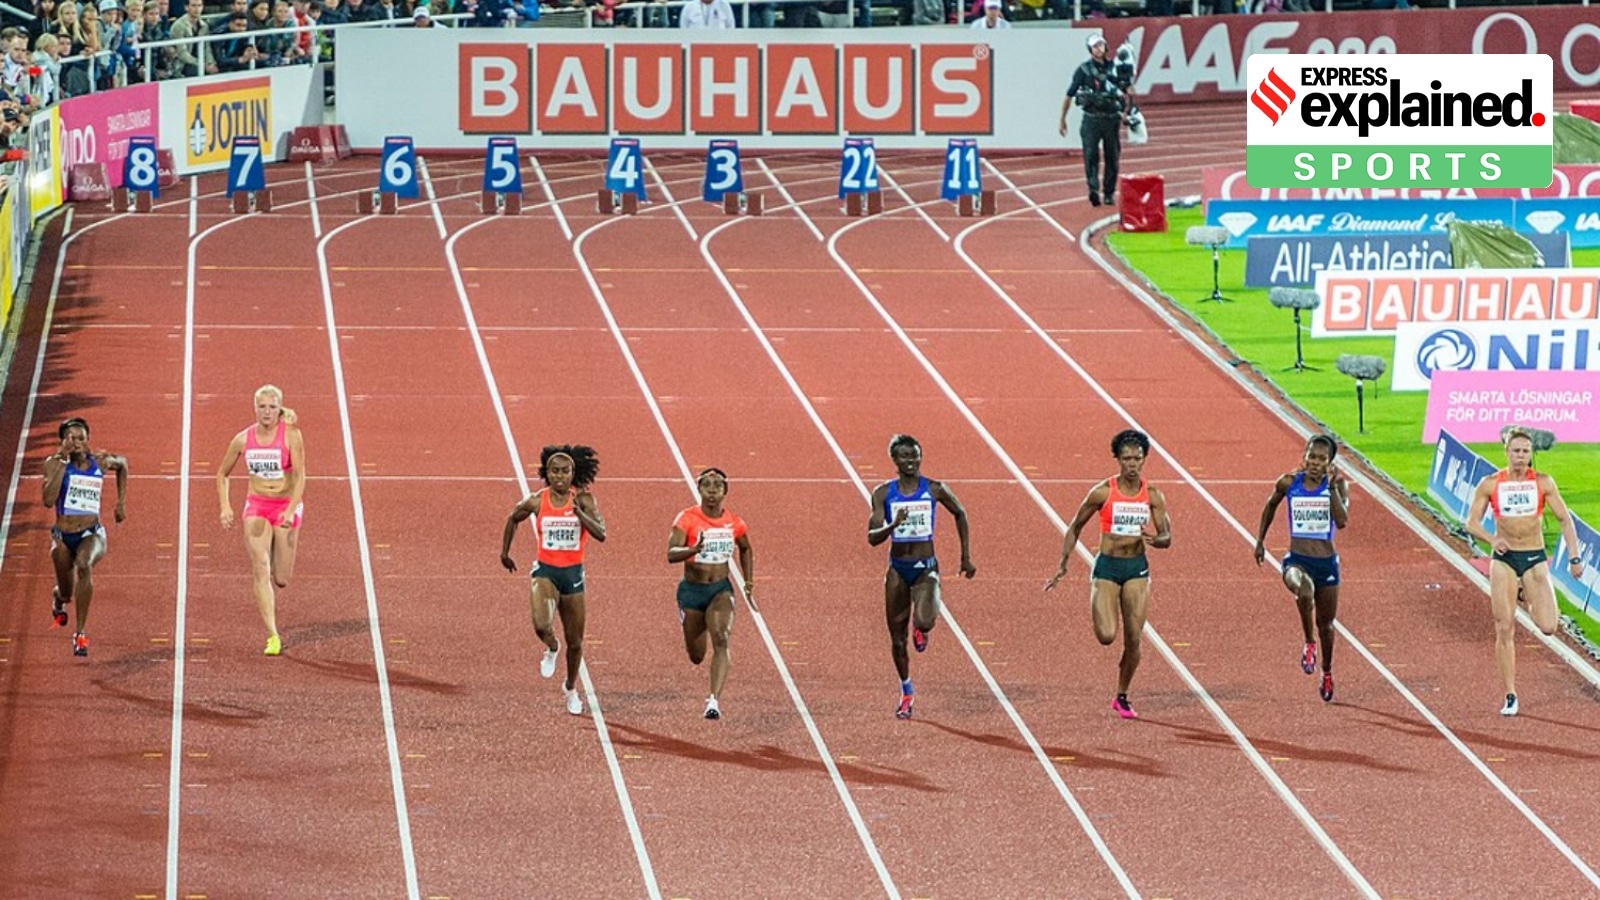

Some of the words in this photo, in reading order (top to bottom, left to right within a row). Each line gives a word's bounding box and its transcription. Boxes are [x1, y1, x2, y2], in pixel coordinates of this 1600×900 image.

[471, 56, 981, 119] BAUHAUS
[209, 97, 268, 152] JOTUN
[130, 147, 155, 186] 8
[234, 146, 259, 187] 7
[385, 146, 412, 186] 6
[492, 146, 516, 188] 5
[610, 147, 638, 188] 4
[710, 149, 738, 190] 3
[1267, 213, 1325, 232] IAAF
[1328, 212, 1428, 232] Diamond
[1270, 240, 1453, 283] All-Athletic
[1330, 283, 1593, 322] BAUHAU
[1447, 405, 1478, 422] FÖR
[1482, 408, 1510, 422] DITT
[1514, 408, 1579, 422] BADRUM.
[1448, 391, 1506, 405] SMARTA
[1510, 389, 1592, 405] LÖSNINGAR
[548, 529, 575, 541] PIERRE
[1293, 509, 1329, 521] SOLOMON
